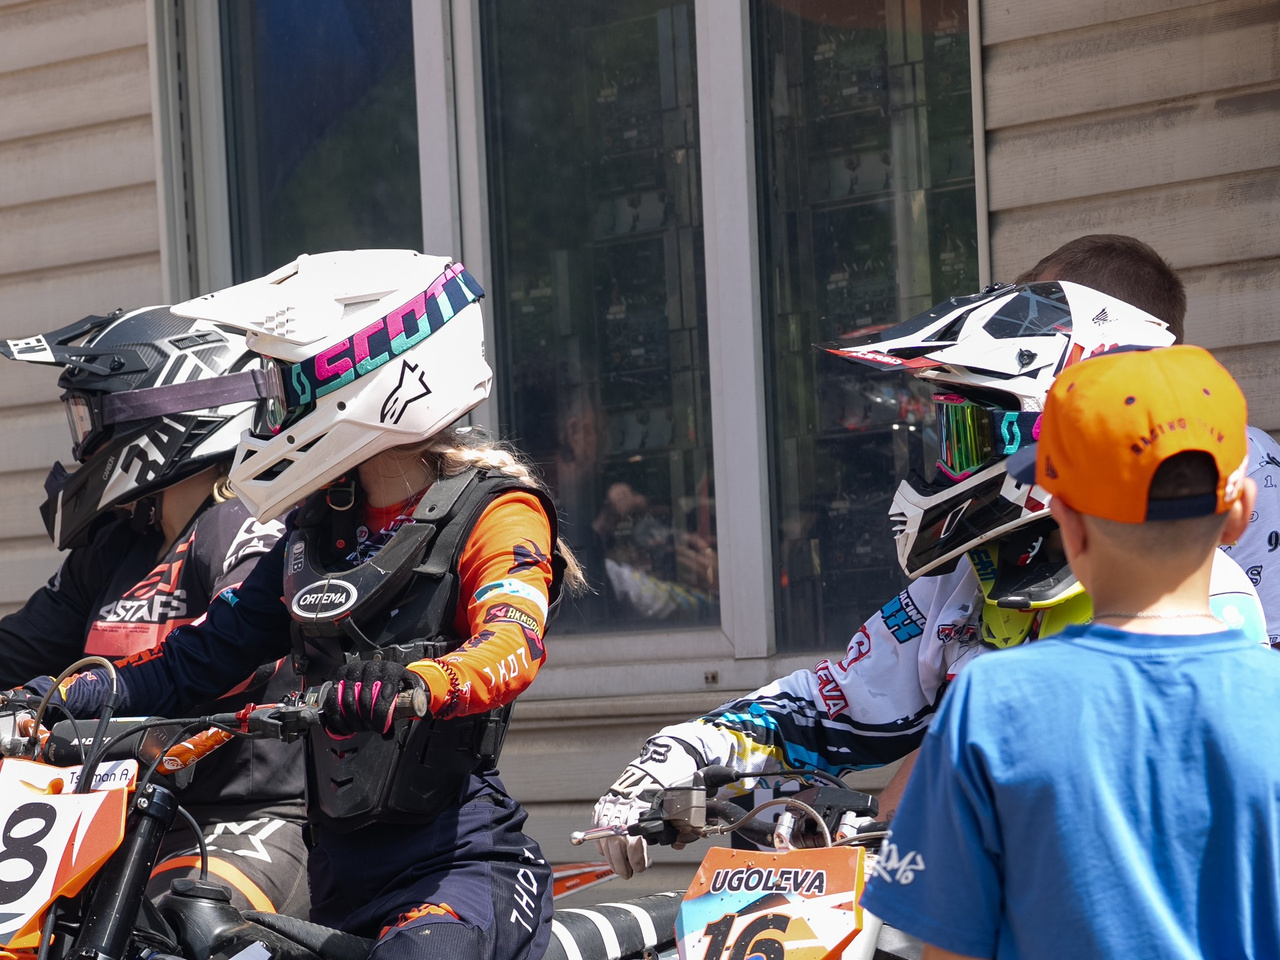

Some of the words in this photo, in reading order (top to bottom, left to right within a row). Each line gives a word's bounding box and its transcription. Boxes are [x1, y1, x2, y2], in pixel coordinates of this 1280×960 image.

[314, 262, 477, 400] SCOTT
[102, 455, 115, 481] CARBON
[300, 592, 346, 606] ORTEMA
[710, 868, 827, 896] UGOLEVA
